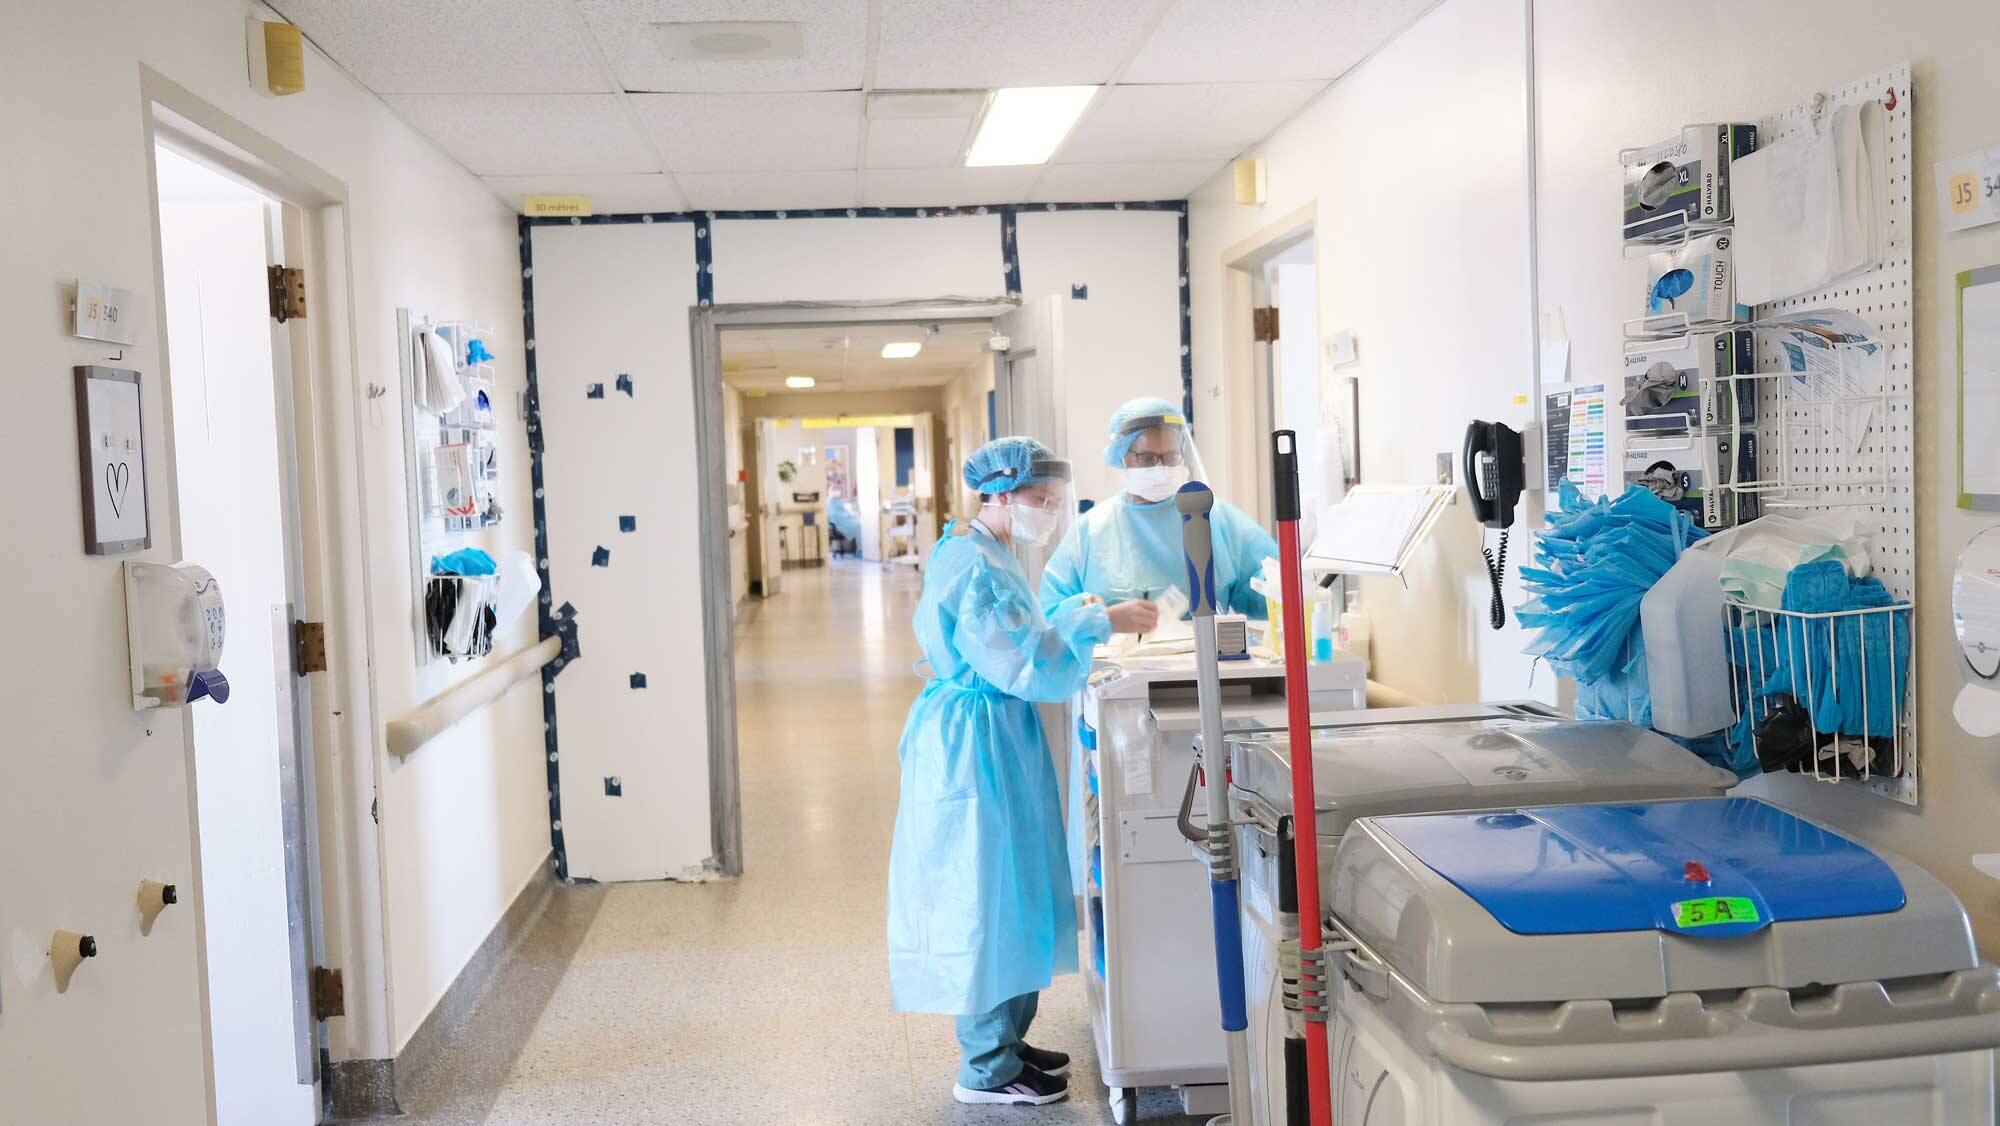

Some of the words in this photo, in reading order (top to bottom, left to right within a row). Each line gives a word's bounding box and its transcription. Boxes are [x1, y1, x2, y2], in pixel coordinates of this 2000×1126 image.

[1721, 133, 1728, 144] XL
[1679, 170, 1689, 183] XL
[1956, 182, 1972, 204] J5
[535, 203, 546, 211] 30
[1719, 239, 1728, 249] XL
[1718, 341, 1725, 349] M
[1680, 376, 1687, 387] M
[1683, 475, 1688, 488] S
